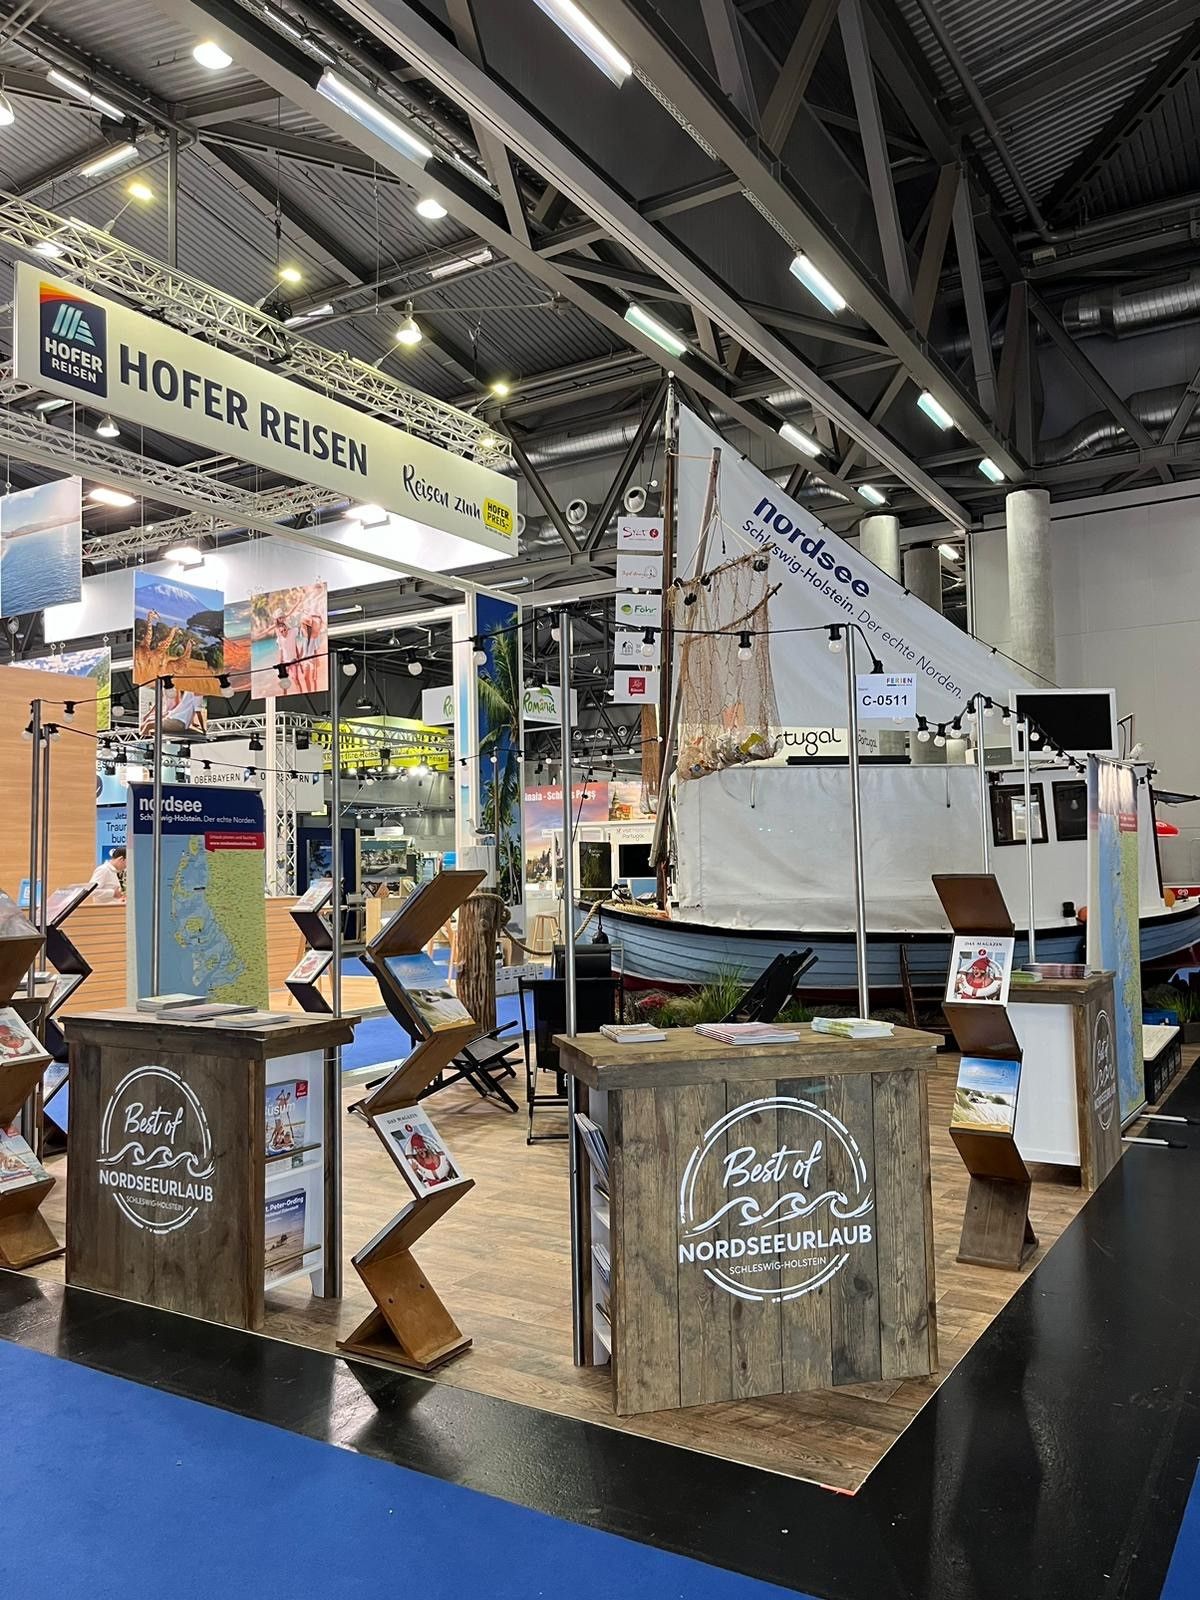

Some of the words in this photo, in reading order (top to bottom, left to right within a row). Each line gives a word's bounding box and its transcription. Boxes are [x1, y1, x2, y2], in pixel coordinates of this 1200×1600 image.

[45, 338, 104, 374] HOFER
[51, 357, 97, 384] REISEN
[119, 343, 249, 432] HOFER
[260, 401, 368, 476] REISEN
[403, 464, 449, 508] Reisen
[487, 502, 510, 520] HOFER
[753, 496, 870, 598] nordsee
[742, 519, 855, 615] Schlswig-Holstein.
[857, 609, 882, 633] Der
[881, 632, 916, 660] echte
[915, 655, 963, 699] Norden.
[862, 695, 908, 706] C-0511
[776, 728, 842, 755] tugal
[194, 773, 240, 784] OBERBAYERN
[139, 813, 202, 823] Schlwig-Holstein.
[203, 815, 215, 823] Der
[124, 1102, 171, 1135] Best
[165, 1106, 184, 1144] of
[265, 1103, 296, 1117] üsum
[723, 1145, 804, 1189] Best
[792, 1139, 823, 1188] of
[99, 1169, 213, 1202] NORDSEEURLAUB
[126, 1195, 184, 1212] SCHLESWIG-HOLSTEIN
[679, 1224, 872, 1264] NORDSEEURLAUB
[729, 1256, 827, 1275] SCHLESWIG-HOLSTEIN
